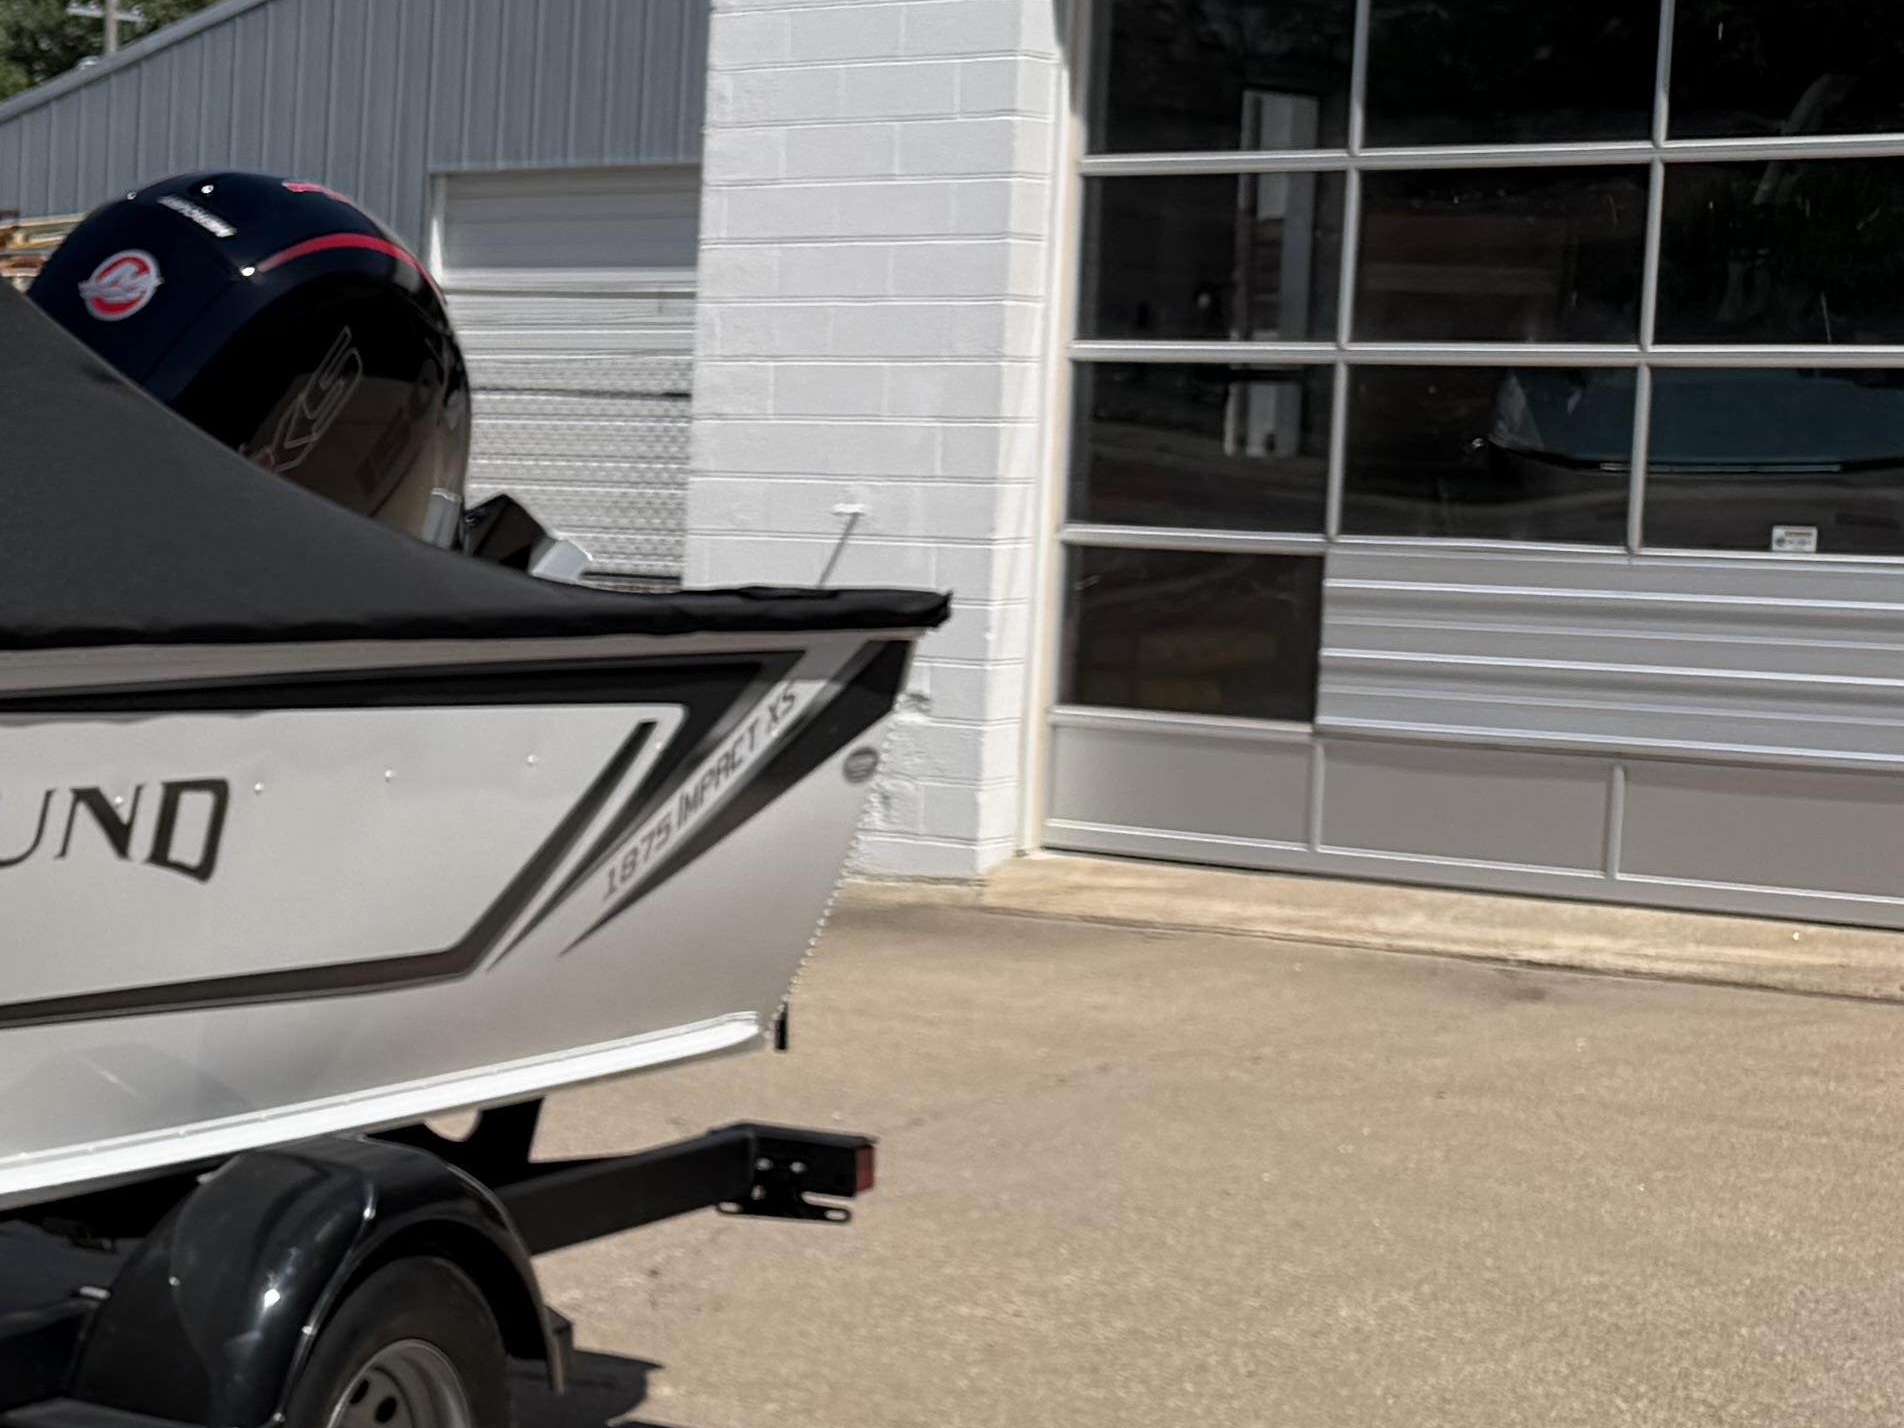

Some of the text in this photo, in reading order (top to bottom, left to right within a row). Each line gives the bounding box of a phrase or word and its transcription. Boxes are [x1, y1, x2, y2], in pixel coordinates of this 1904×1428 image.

[603, 681, 797, 903] 1875 IMPACT XS
